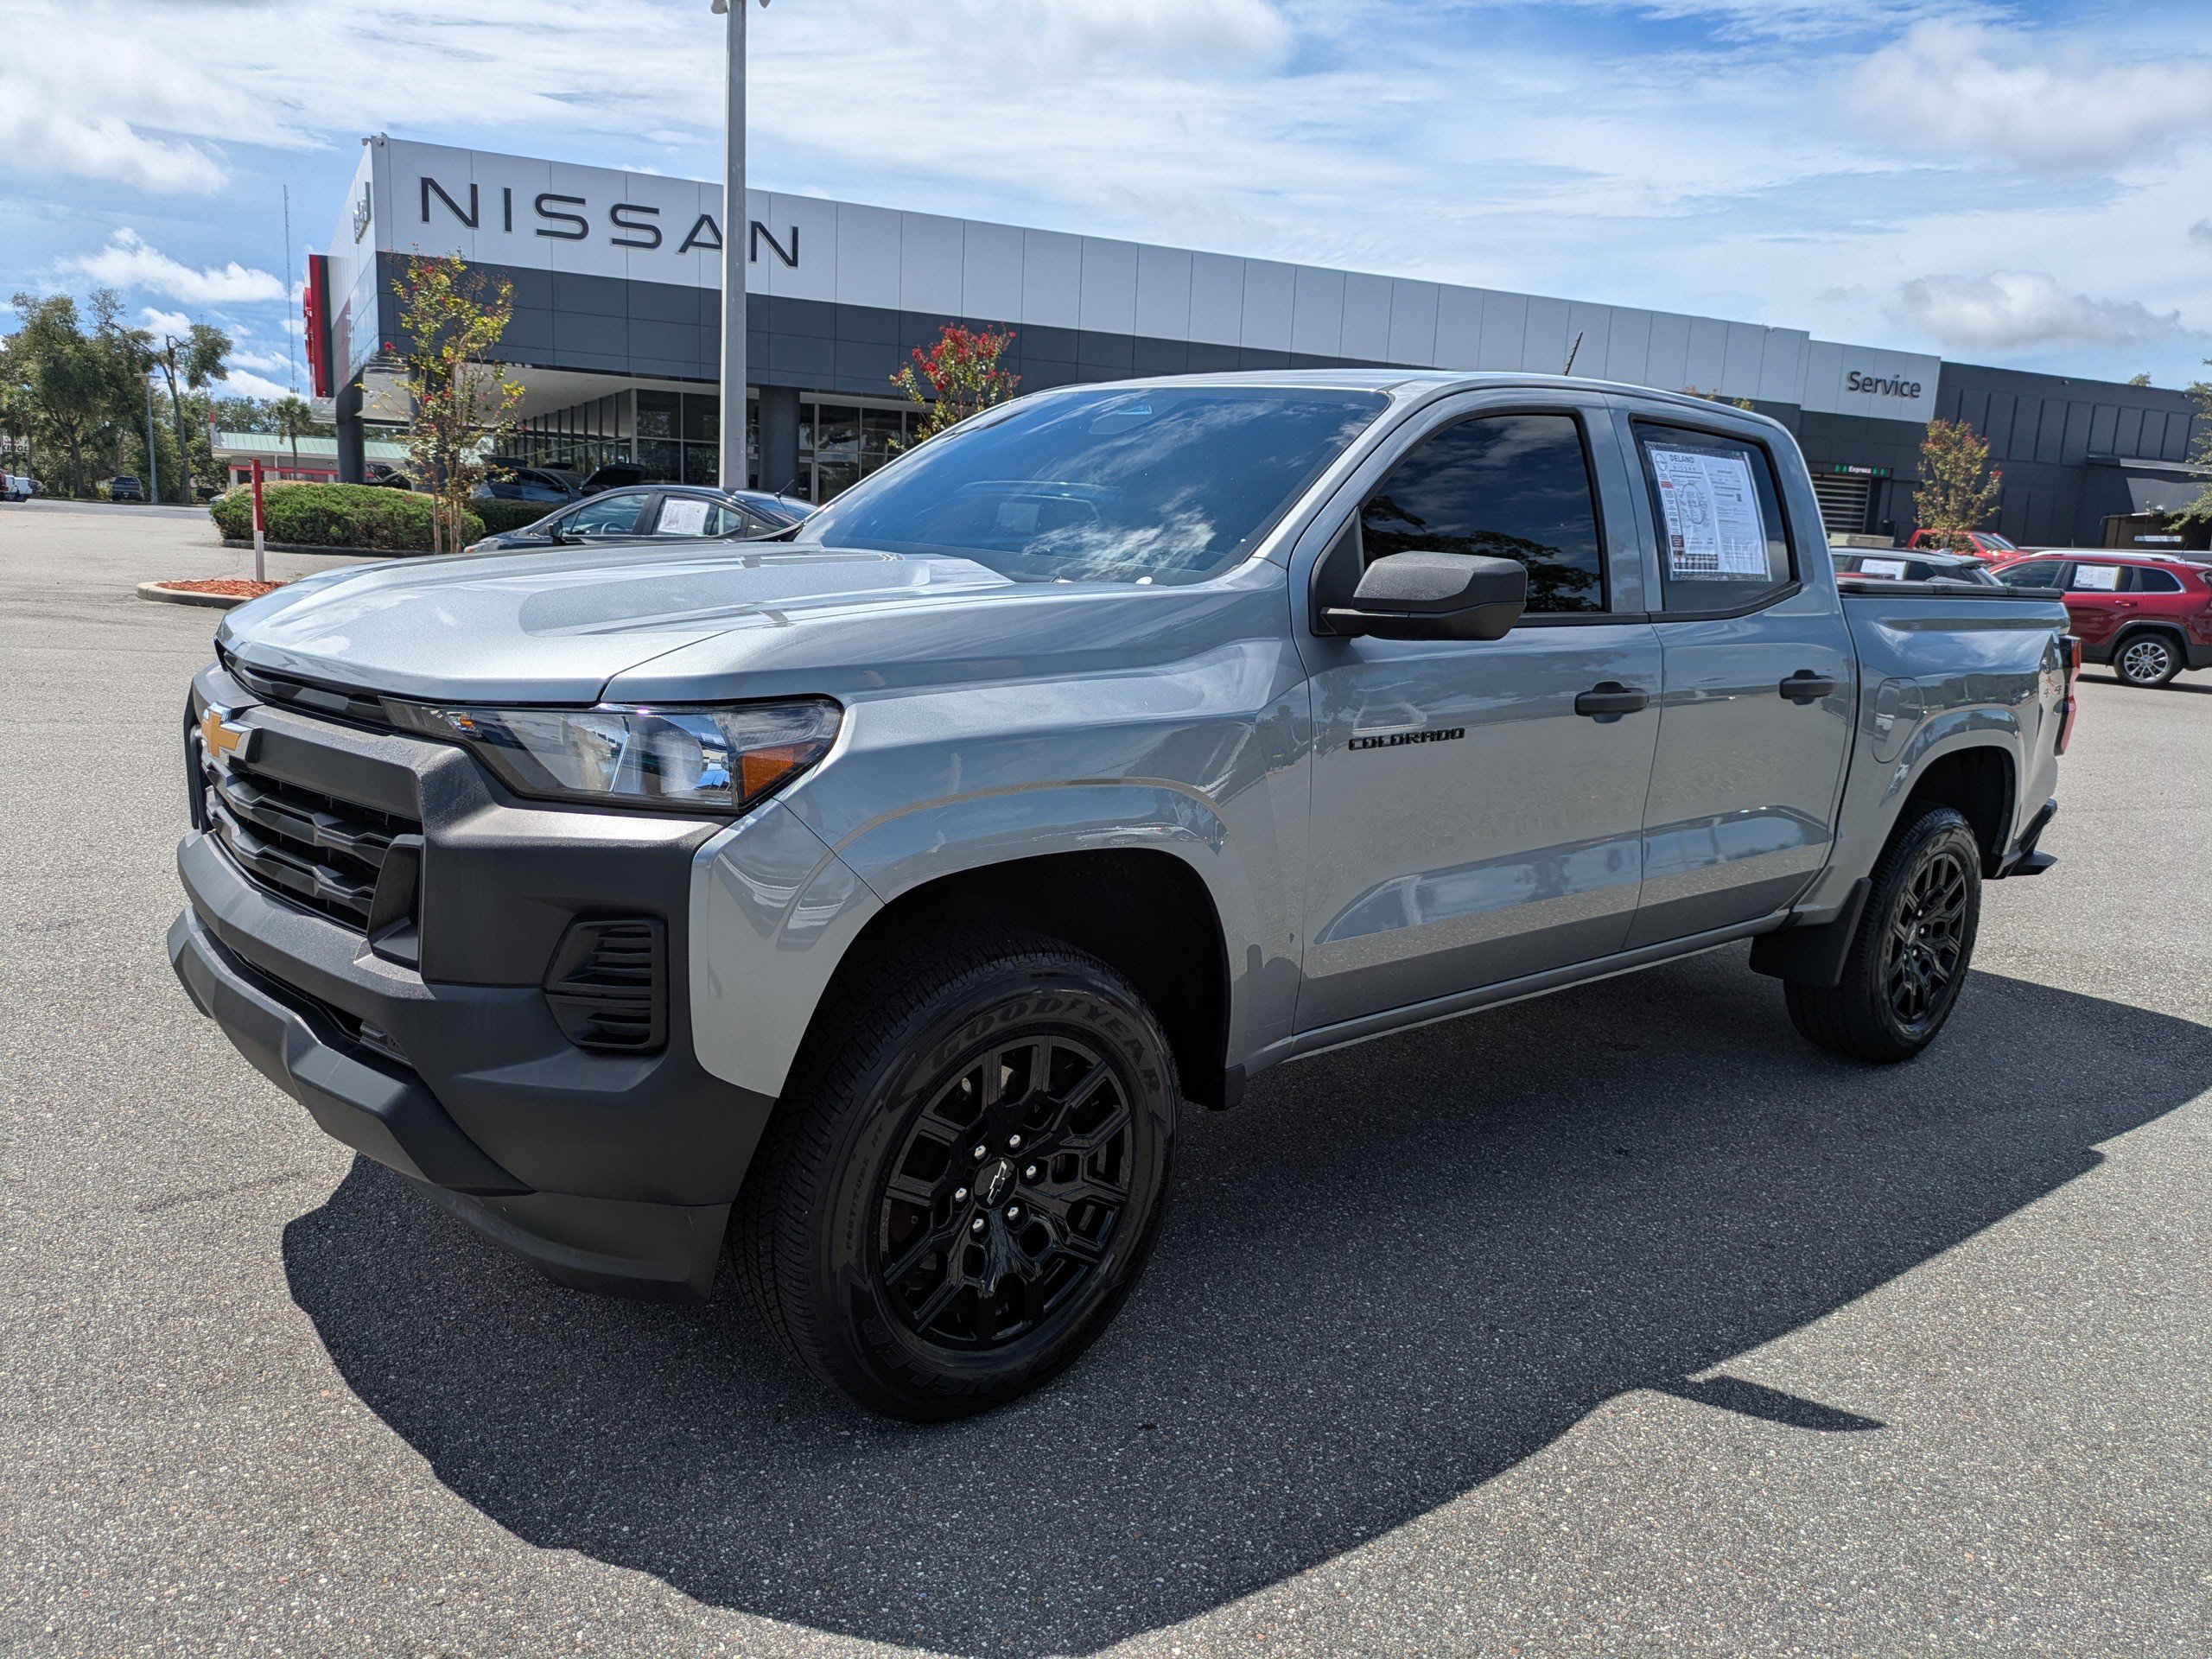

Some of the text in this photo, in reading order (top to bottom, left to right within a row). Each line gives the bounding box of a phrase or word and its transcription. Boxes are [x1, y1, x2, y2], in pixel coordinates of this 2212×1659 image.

[420, 176, 800, 270] NISSAN
[1847, 371, 1922, 398] Service
[1669, 454, 1695, 464] DELAND
[1348, 727, 1465, 751] COLORADO
[931, 997, 1161, 1096] GOODYEAR
